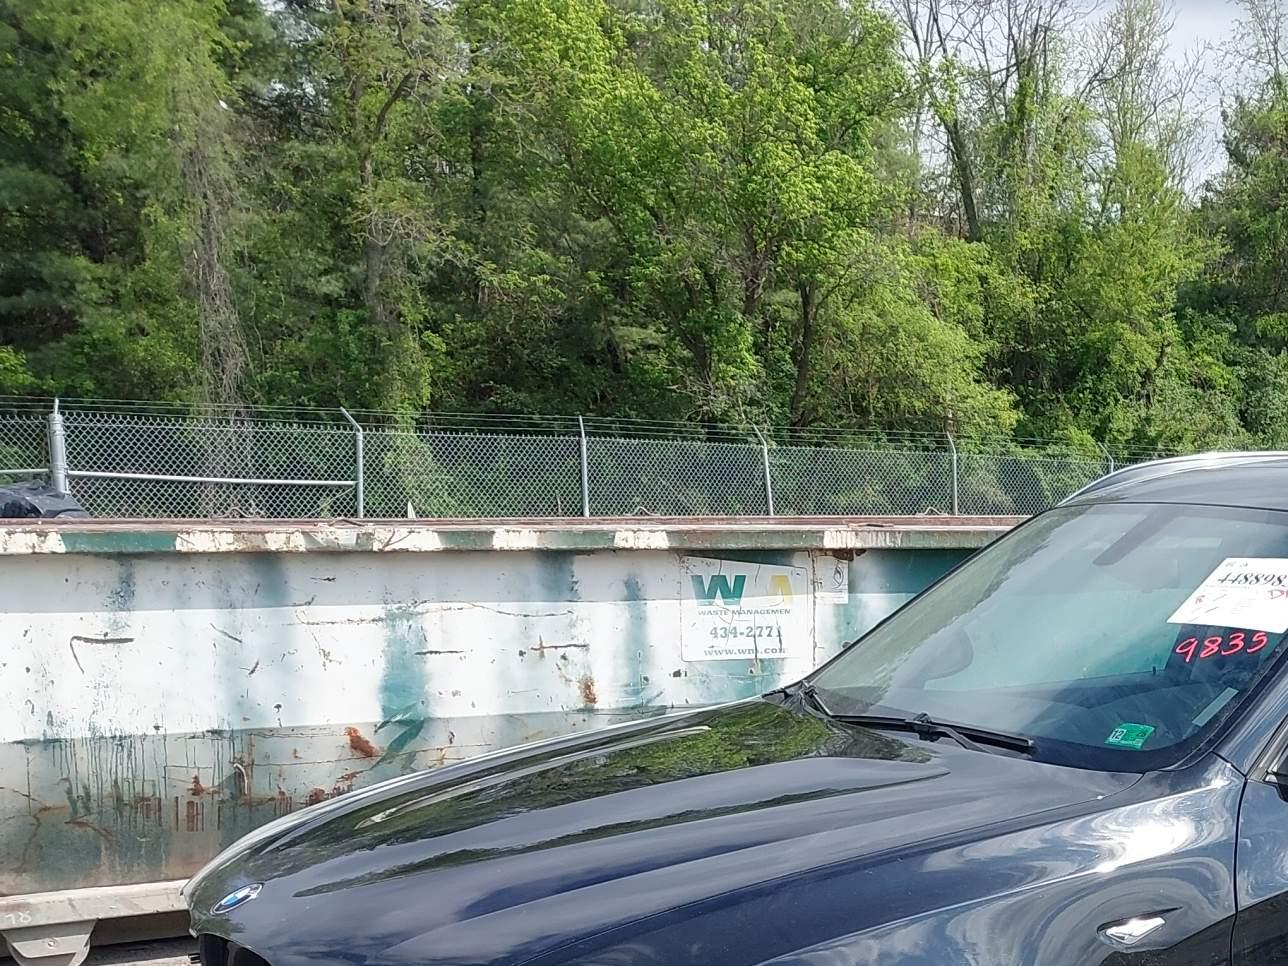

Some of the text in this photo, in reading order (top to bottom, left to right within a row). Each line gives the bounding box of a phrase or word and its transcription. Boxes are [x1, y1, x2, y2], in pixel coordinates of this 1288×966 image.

[709, 625, 784, 639] 434-2771
[1175, 631, 1268, 663] 9835
[1111, 730, 1124, 740] 12
